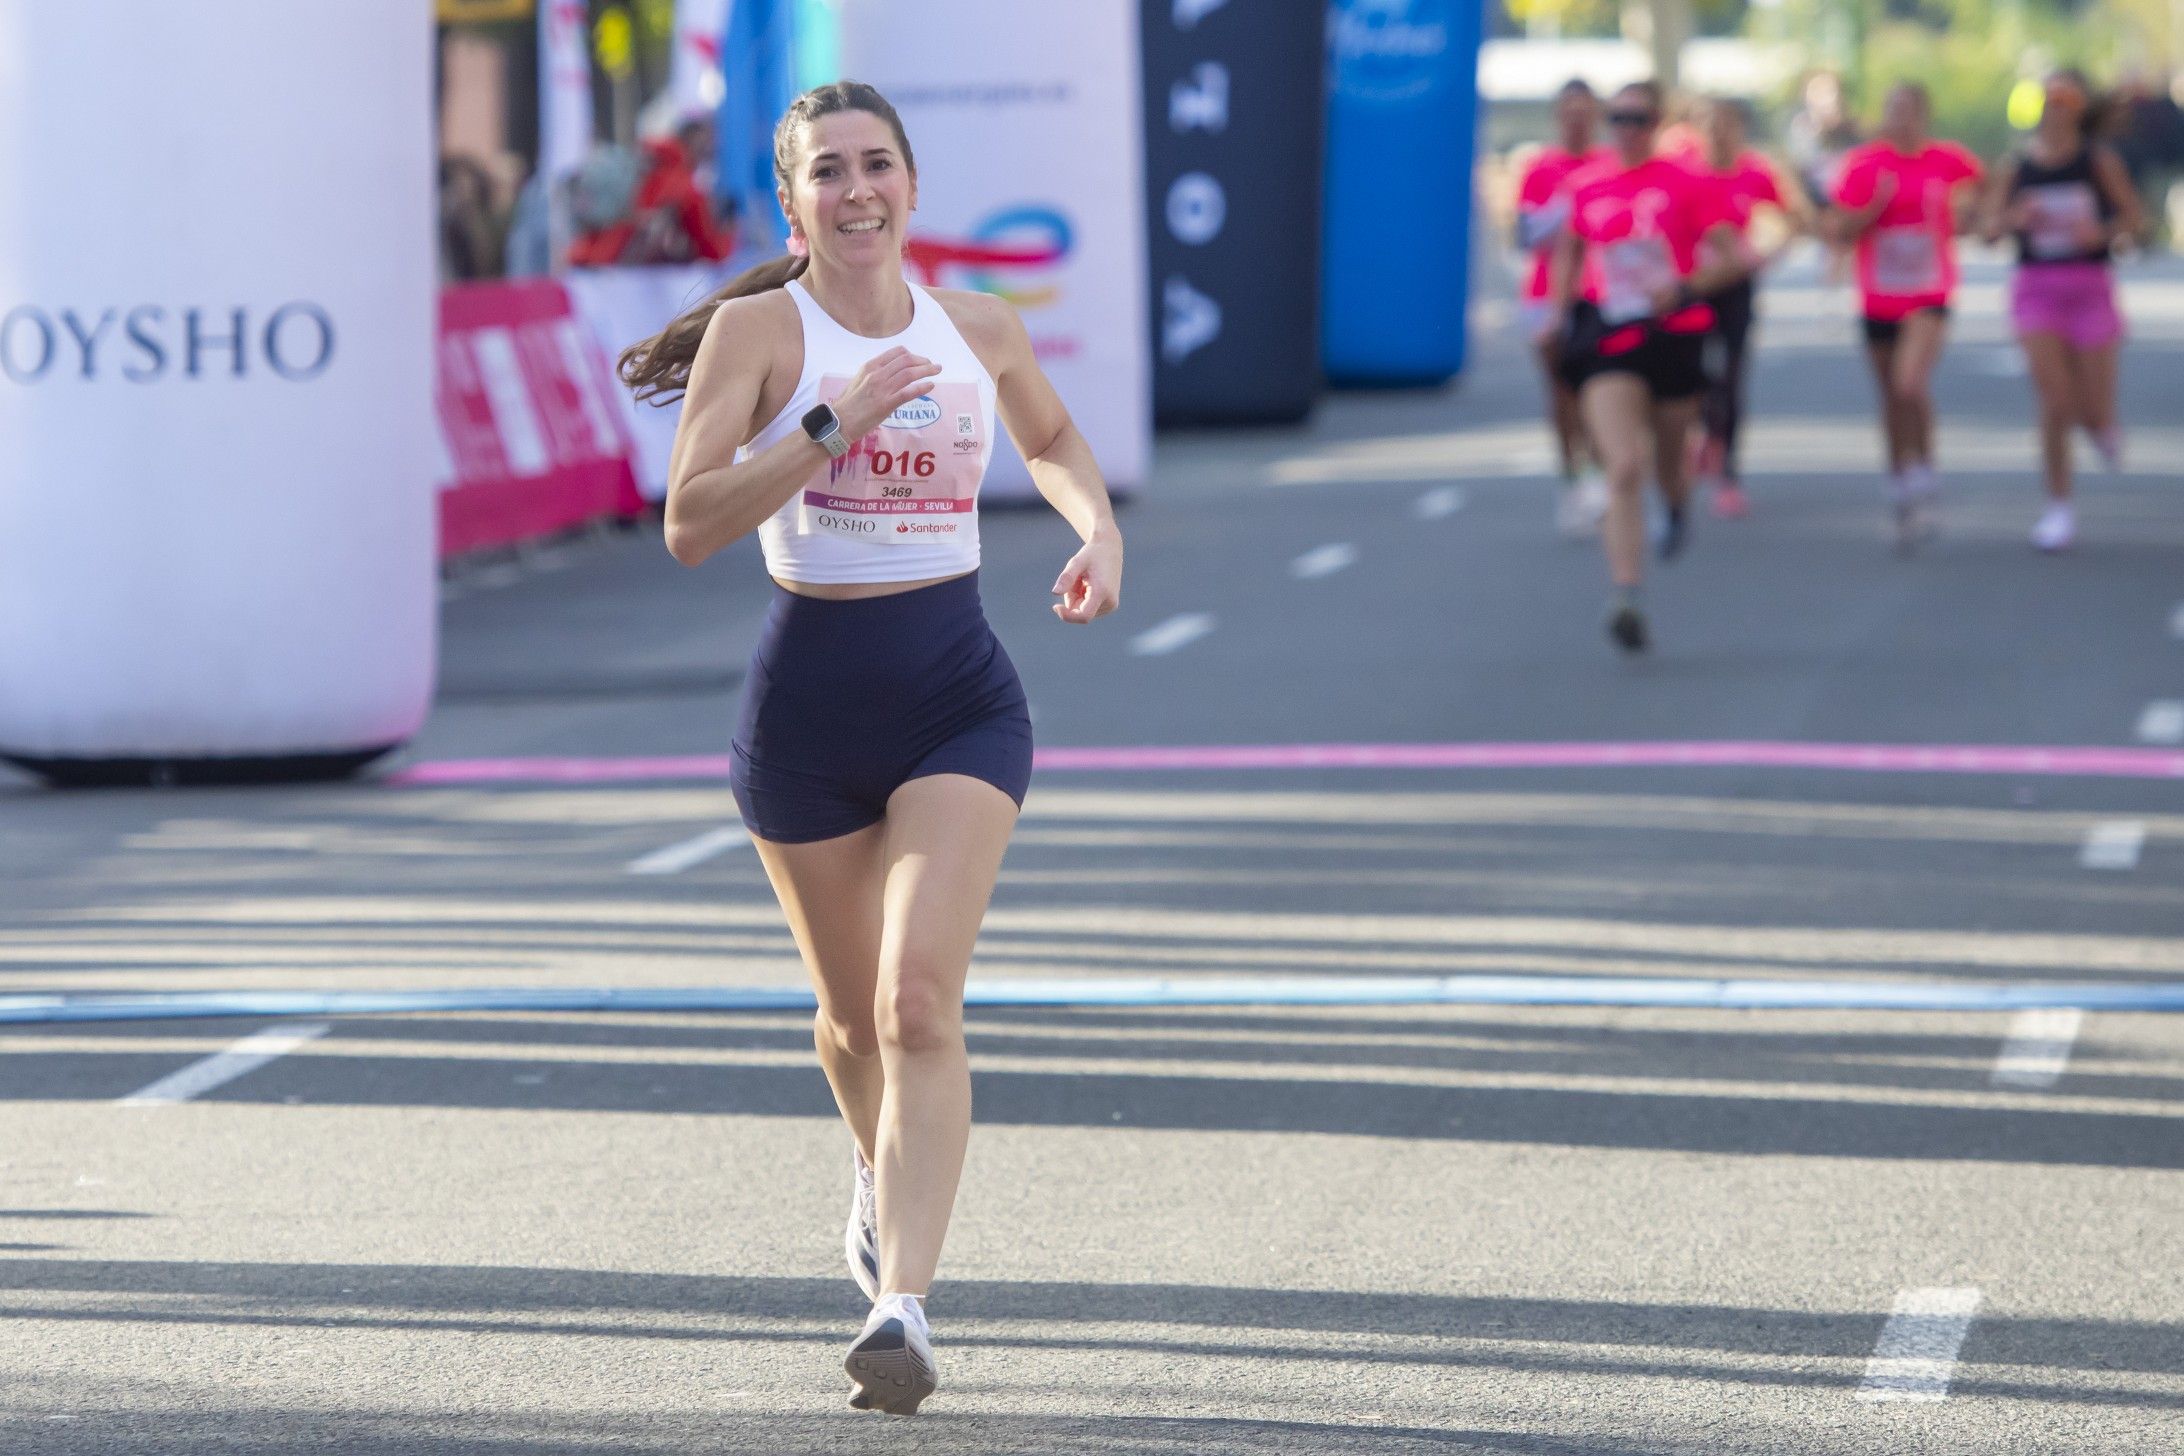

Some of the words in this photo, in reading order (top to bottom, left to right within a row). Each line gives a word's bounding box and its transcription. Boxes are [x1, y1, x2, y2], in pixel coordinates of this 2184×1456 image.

[1, 301, 335, 384] OYSHO
[871, 450, 936, 477] 016
[881, 487, 912, 498] 3469
[827, 499, 866, 511] CARRERA
[867, 502, 878, 511] DE
[879, 502, 890, 511] LA
[818, 514, 876, 533] OYSHO
[910, 522, 958, 533] Santander
